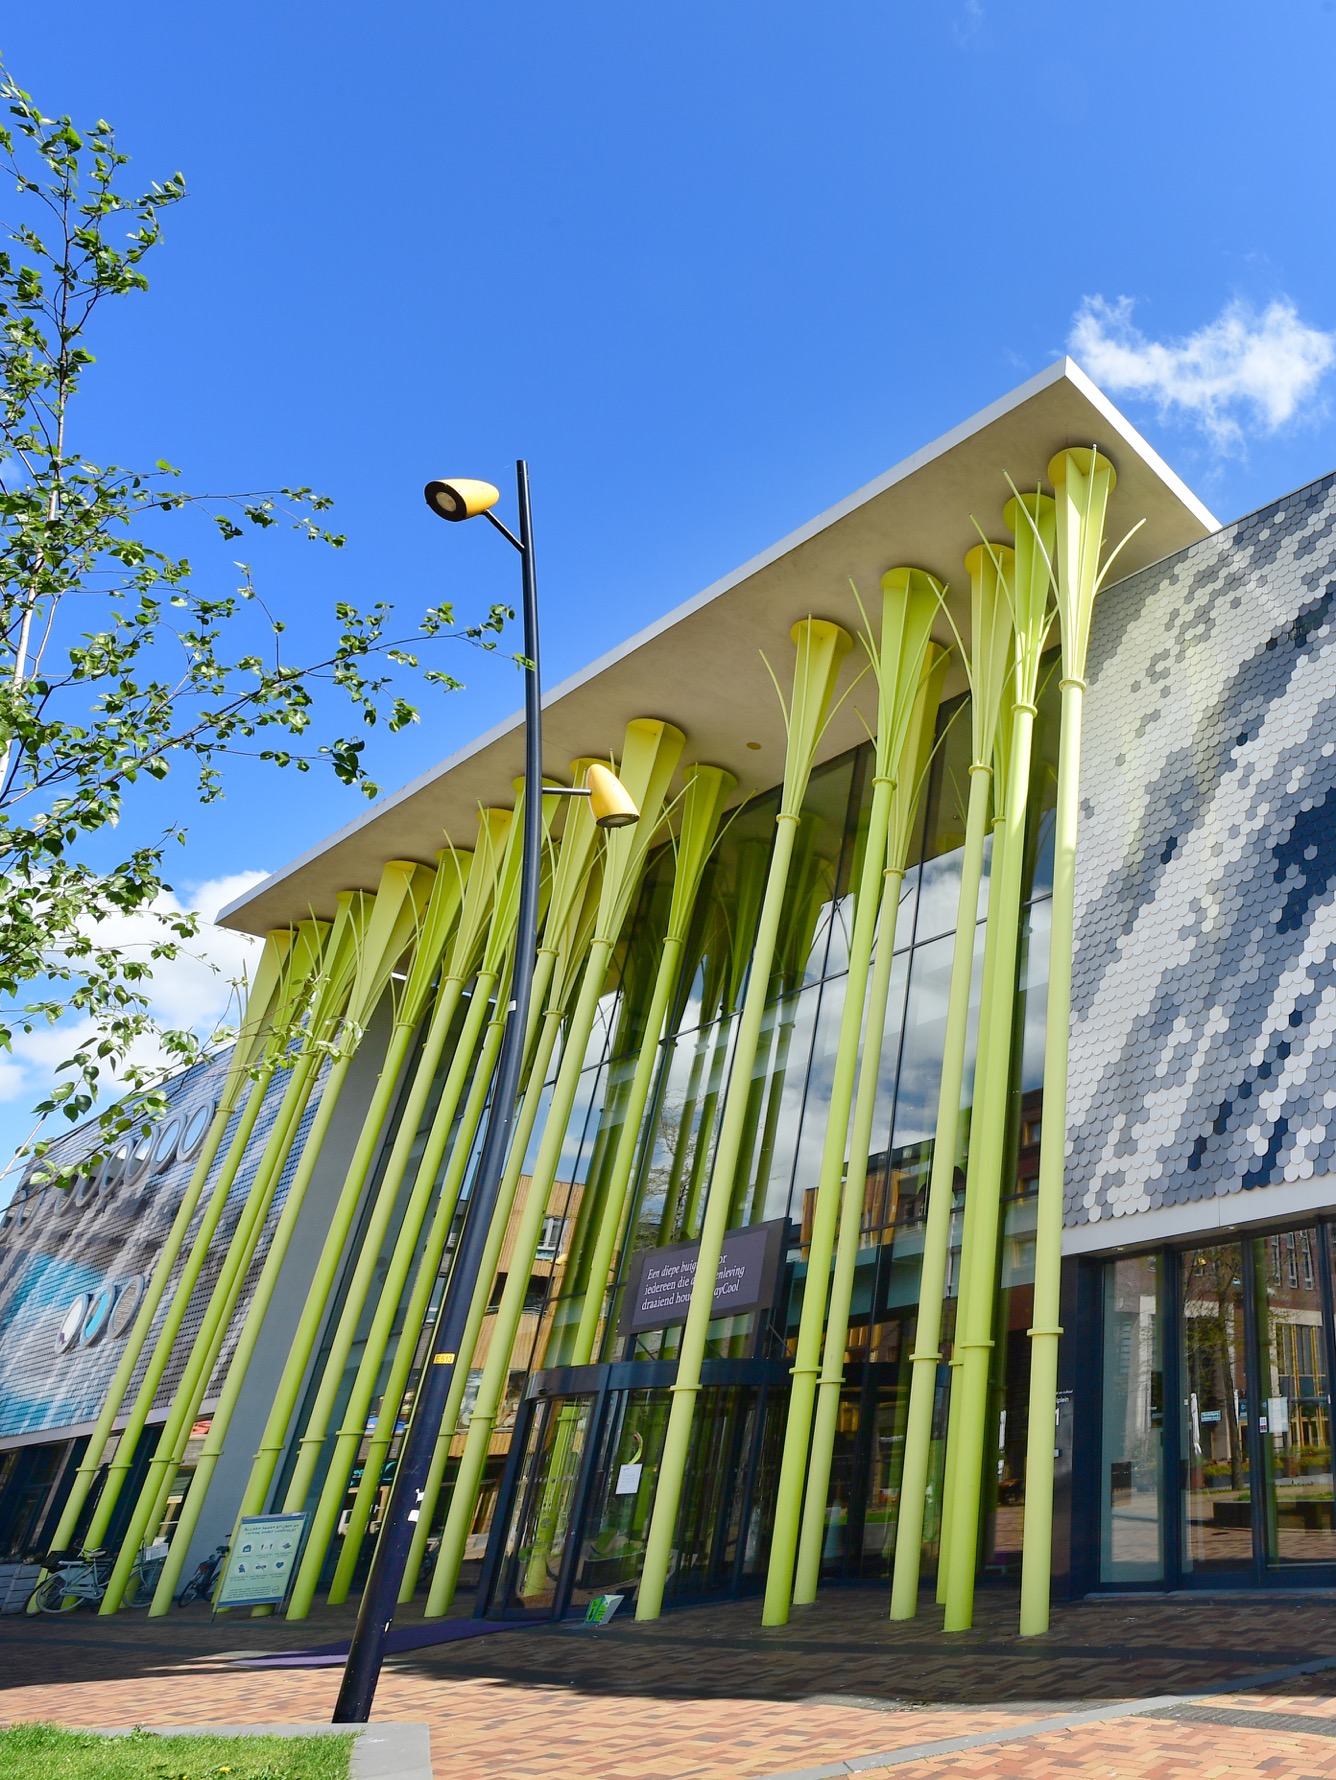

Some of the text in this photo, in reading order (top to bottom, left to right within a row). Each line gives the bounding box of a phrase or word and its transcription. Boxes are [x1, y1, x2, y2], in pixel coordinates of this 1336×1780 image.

[647, 1268, 660, 1280] Een
[660, 1264, 680, 1278] diepe
[680, 1259, 697, 1274] buig
[641, 1292, 675, 1311] draaiend
[675, 1292, 691, 1304] hou
[714, 1279, 739, 1298] ayCool
[644, 1281, 676, 1296] iedereen
[677, 1275, 690, 1288] die
[436, 1355, 453, 1363] E513
